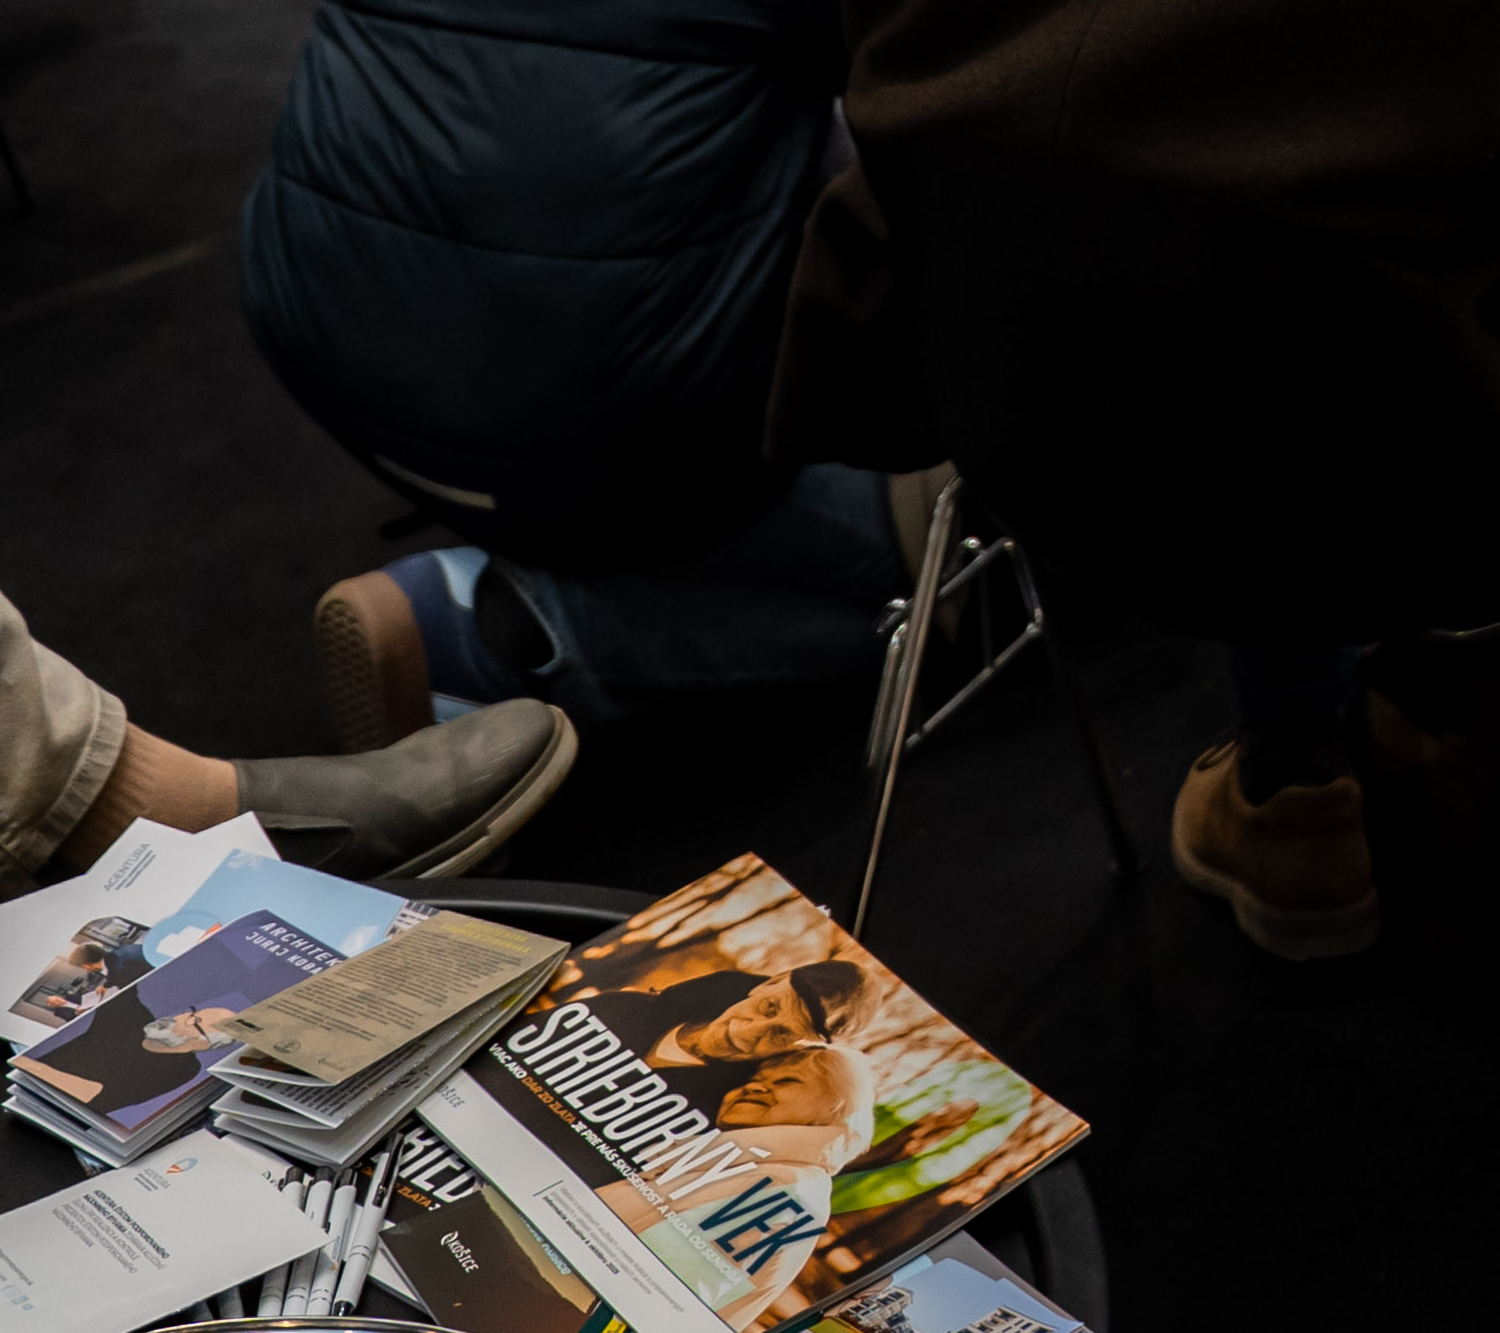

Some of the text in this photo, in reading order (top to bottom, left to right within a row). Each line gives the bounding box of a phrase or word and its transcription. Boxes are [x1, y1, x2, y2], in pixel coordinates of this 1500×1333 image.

[245, 931, 290, 956] JURAJ
[437, 1085, 466, 1108] OŠICE
[488, 1042, 512, 1064] VIAC
[504, 1061, 528, 1079] AKO
[521, 1076, 543, 1094] DAR
[537, 1091, 554, 1104] ZO
[548, 1101, 576, 1124] ZLATA
[571, 1120, 588, 1133] JE
[580, 1129, 603, 1146] PRE
[596, 1143, 619, 1162] NÁS
[656, 1204, 670, 1214] A
[664, 1211, 693, 1238] RADA
[688, 1235, 707, 1250] OD
[506, 1002, 827, 1276] STRIEBORNÝ VEK
[397, 1186, 433, 1208] ZLATA
[449, 1239, 479, 1273] KOŠICE
